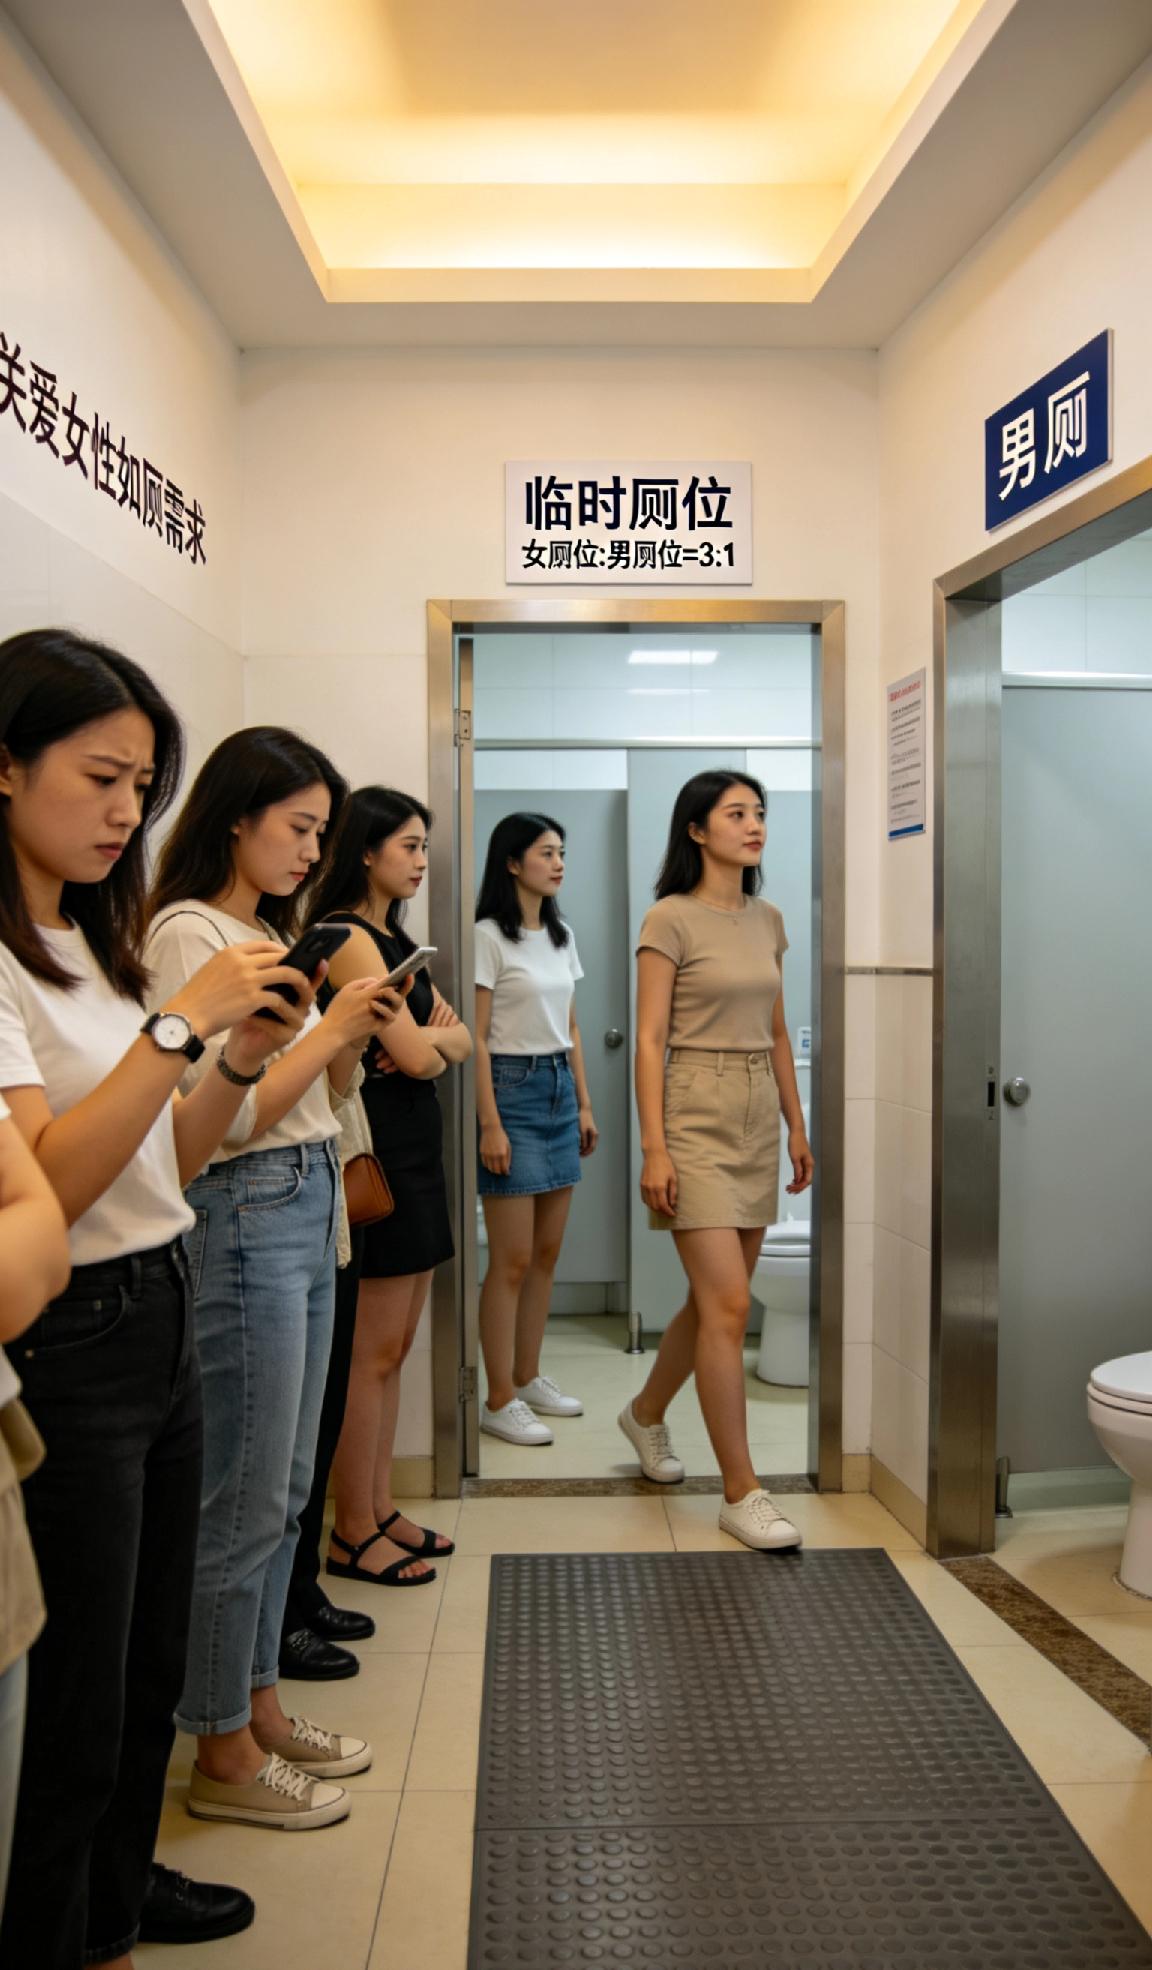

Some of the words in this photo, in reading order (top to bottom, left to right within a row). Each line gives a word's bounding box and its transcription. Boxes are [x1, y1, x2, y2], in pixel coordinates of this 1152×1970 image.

[999, 371, 1090, 501] 男厕
[526, 476, 733, 530] 临时厕位
